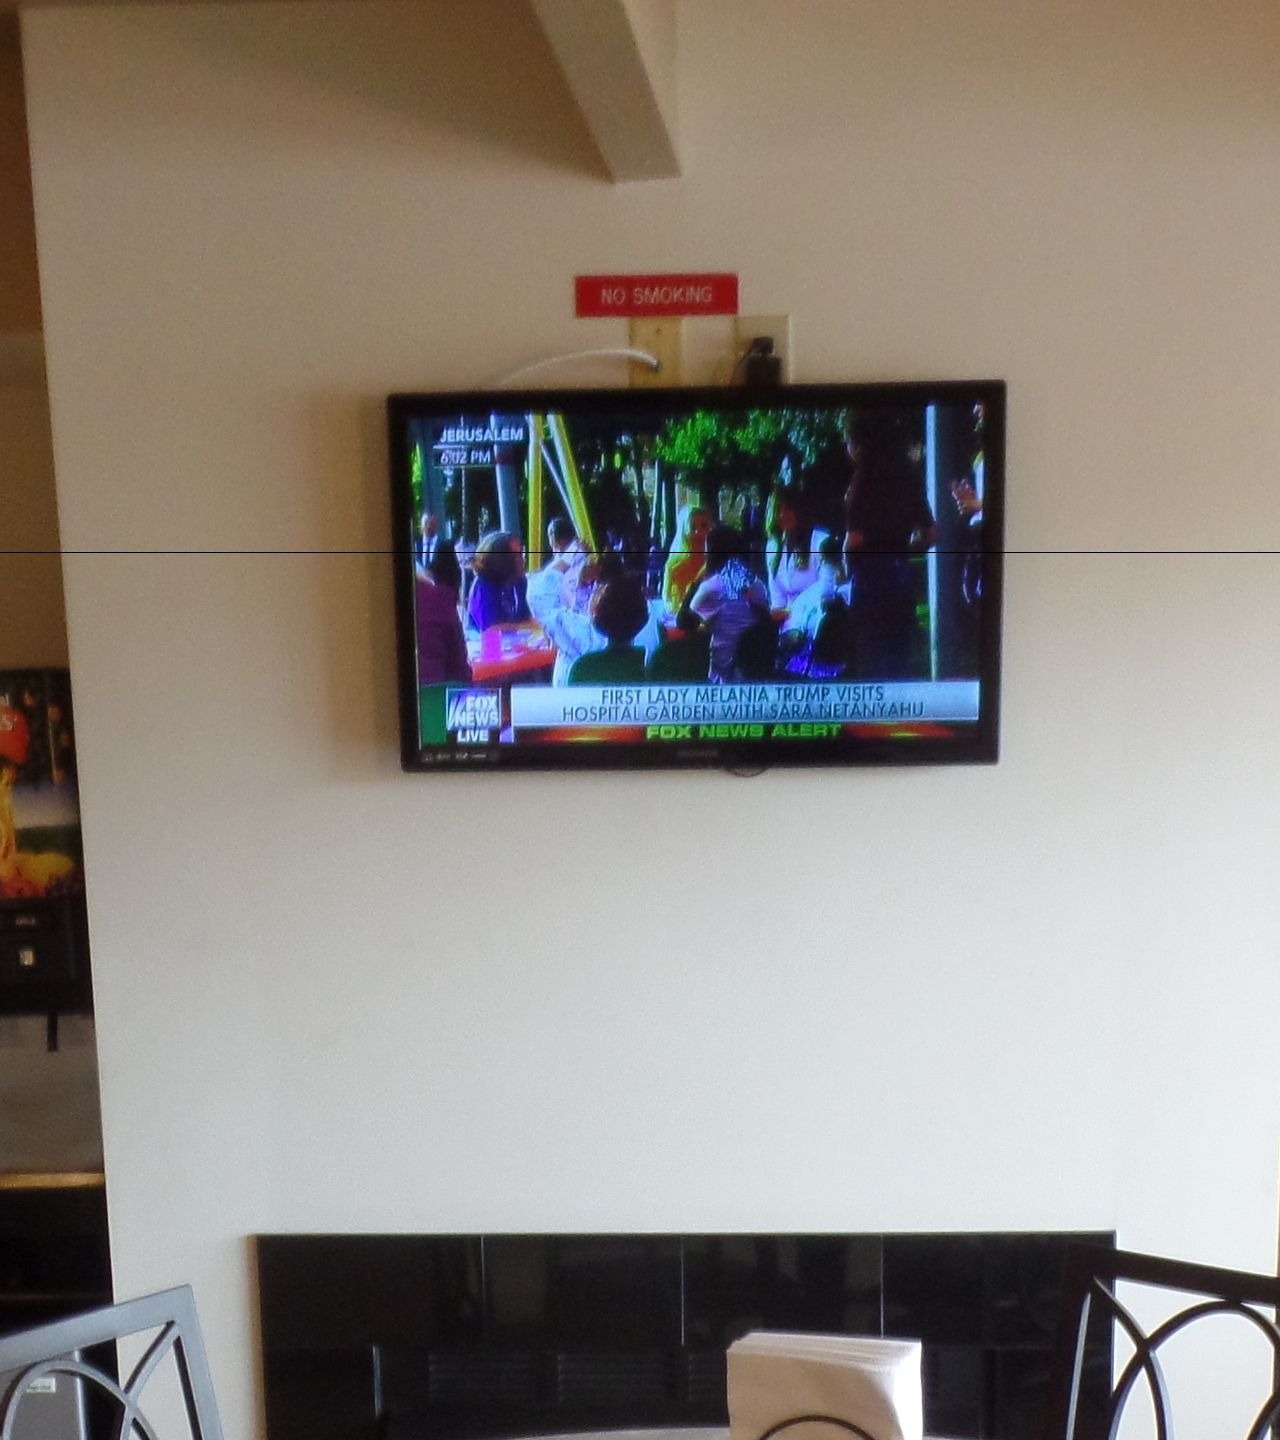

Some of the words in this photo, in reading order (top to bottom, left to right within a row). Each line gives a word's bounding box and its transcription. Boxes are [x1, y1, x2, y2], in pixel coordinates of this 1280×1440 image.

[601, 288, 625, 305] NO
[633, 286, 713, 304] SMOKING
[440, 427, 523, 442] JERUSALEM
[440, 450, 467, 464] 6:02
[470, 449, 491, 463] PM
[466, 695, 498, 710] FOX
[601, 689, 642, 706] FIRST
[647, 688, 689, 704] LADY
[696, 686, 769, 703] MELANIA
[775, 686, 830, 702] TRUMP
[836, 686, 884, 701] VISITS
[455, 711, 499, 726] NEWS
[563, 706, 640, 723] HOSPITAL
[646, 704, 716, 722] GARDEN
[721, 704, 764, 720] WITH
[770, 703, 812, 719] SARA
[817, 702, 925, 719] NETANYAHU
[457, 729, 489, 743] LIVE
[647, 725, 692, 740] FOX
[699, 724, 764, 738] NEWS
[772, 723, 842, 738] ALERT
